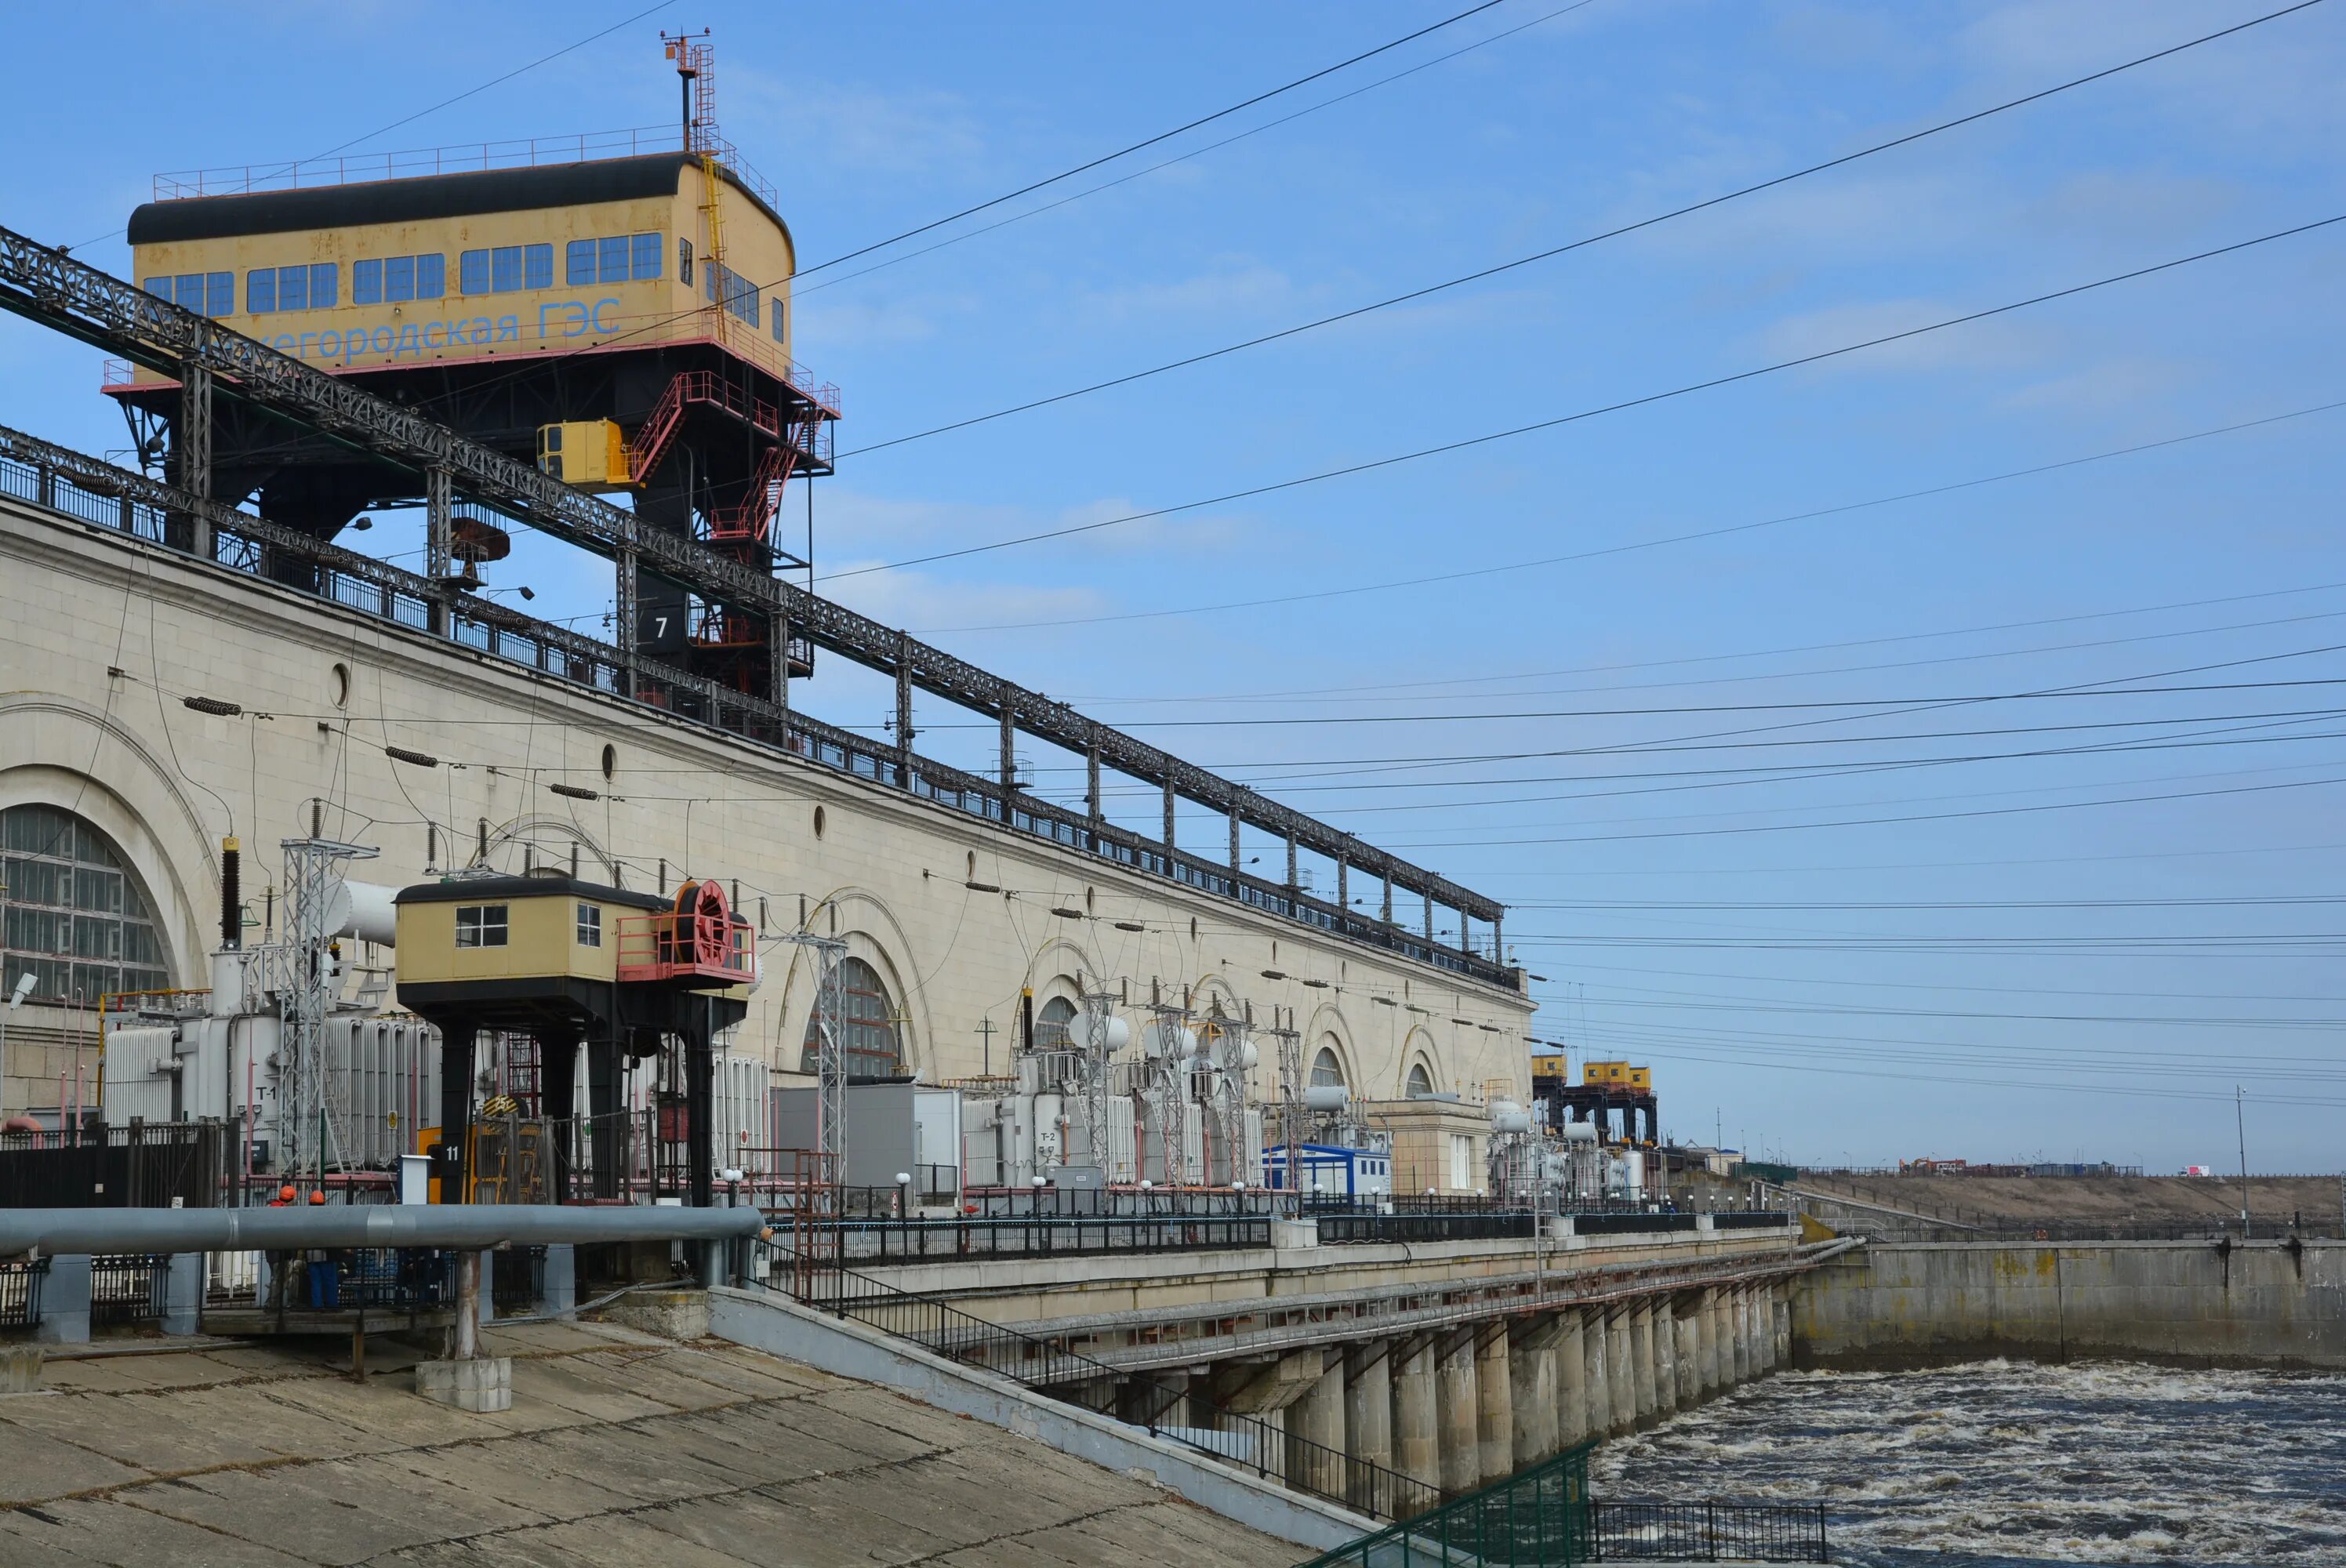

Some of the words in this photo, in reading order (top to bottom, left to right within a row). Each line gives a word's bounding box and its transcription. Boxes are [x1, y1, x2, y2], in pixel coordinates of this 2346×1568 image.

[200, 314, 518, 365] егородская
[539, 298, 620, 339] ГЭС
[656, 617, 667, 638] 7
[446, 1146, 458, 1160] 11
